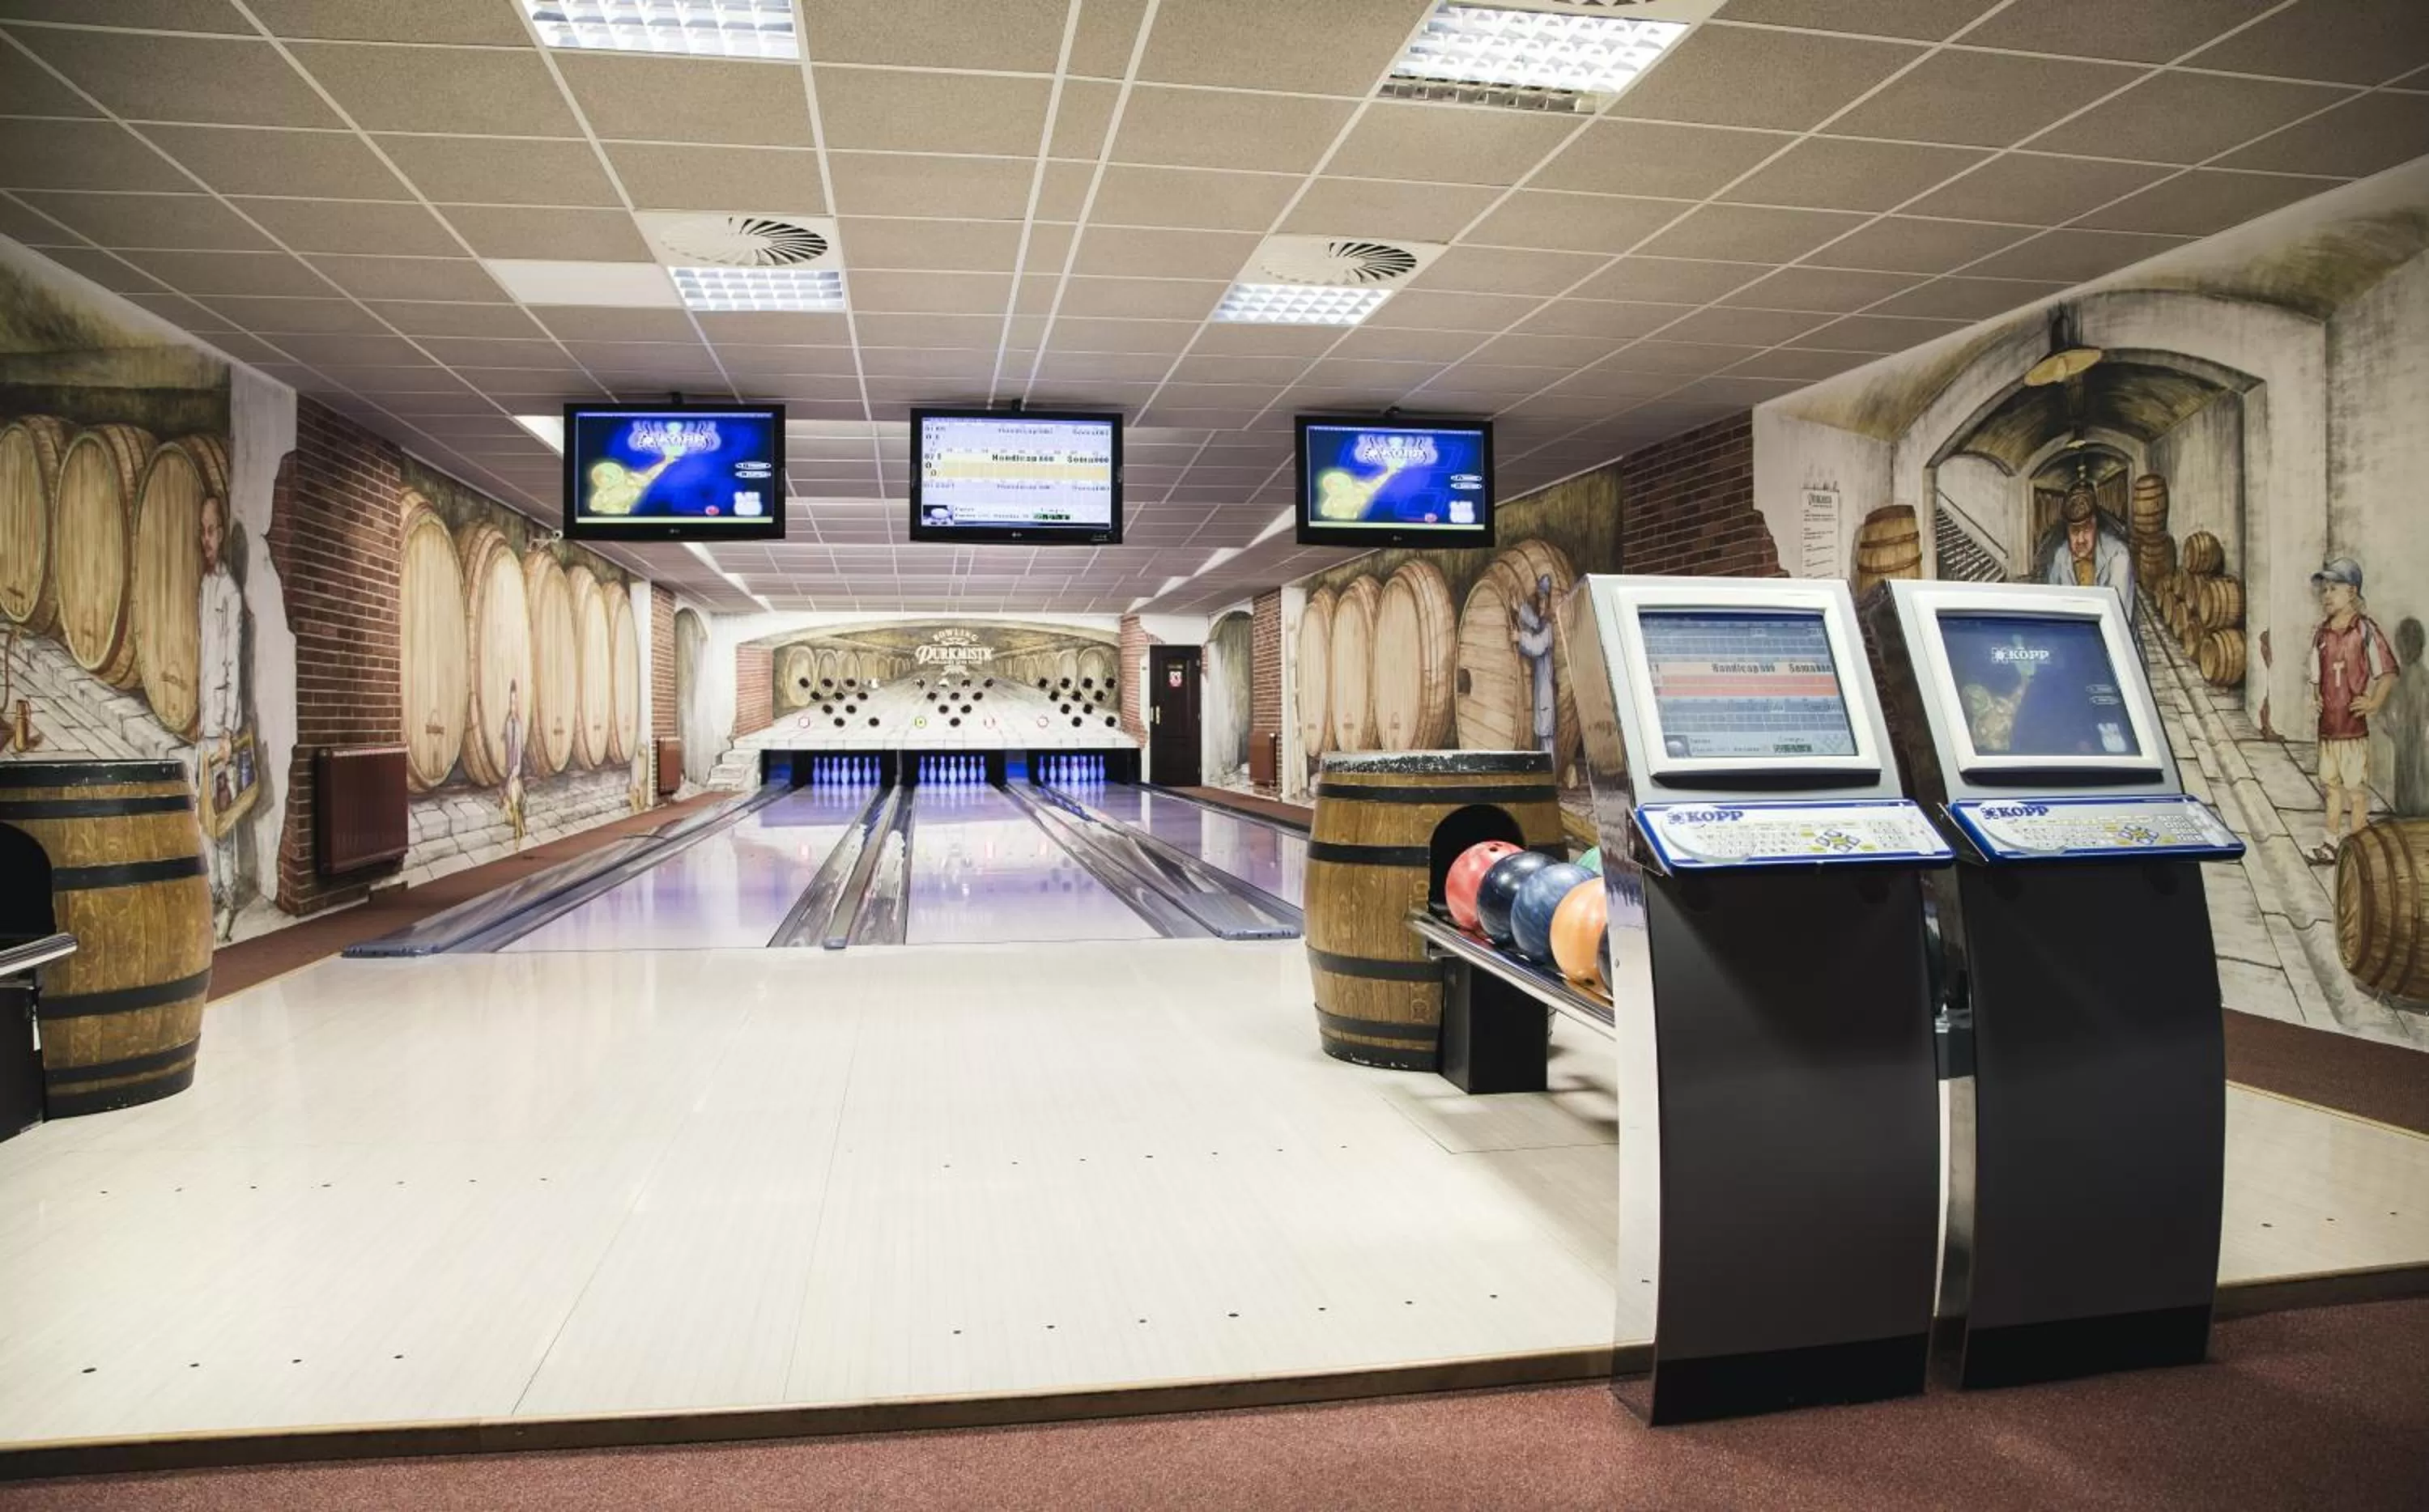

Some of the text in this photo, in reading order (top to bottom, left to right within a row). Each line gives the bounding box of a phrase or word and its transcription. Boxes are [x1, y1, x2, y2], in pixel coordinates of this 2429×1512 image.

[933, 628, 979, 642] BOWLING
[2009, 650, 2049, 660] KOPP
[1685, 810, 1744, 822] KOPP
[1997, 805, 2049, 817] KOPP
